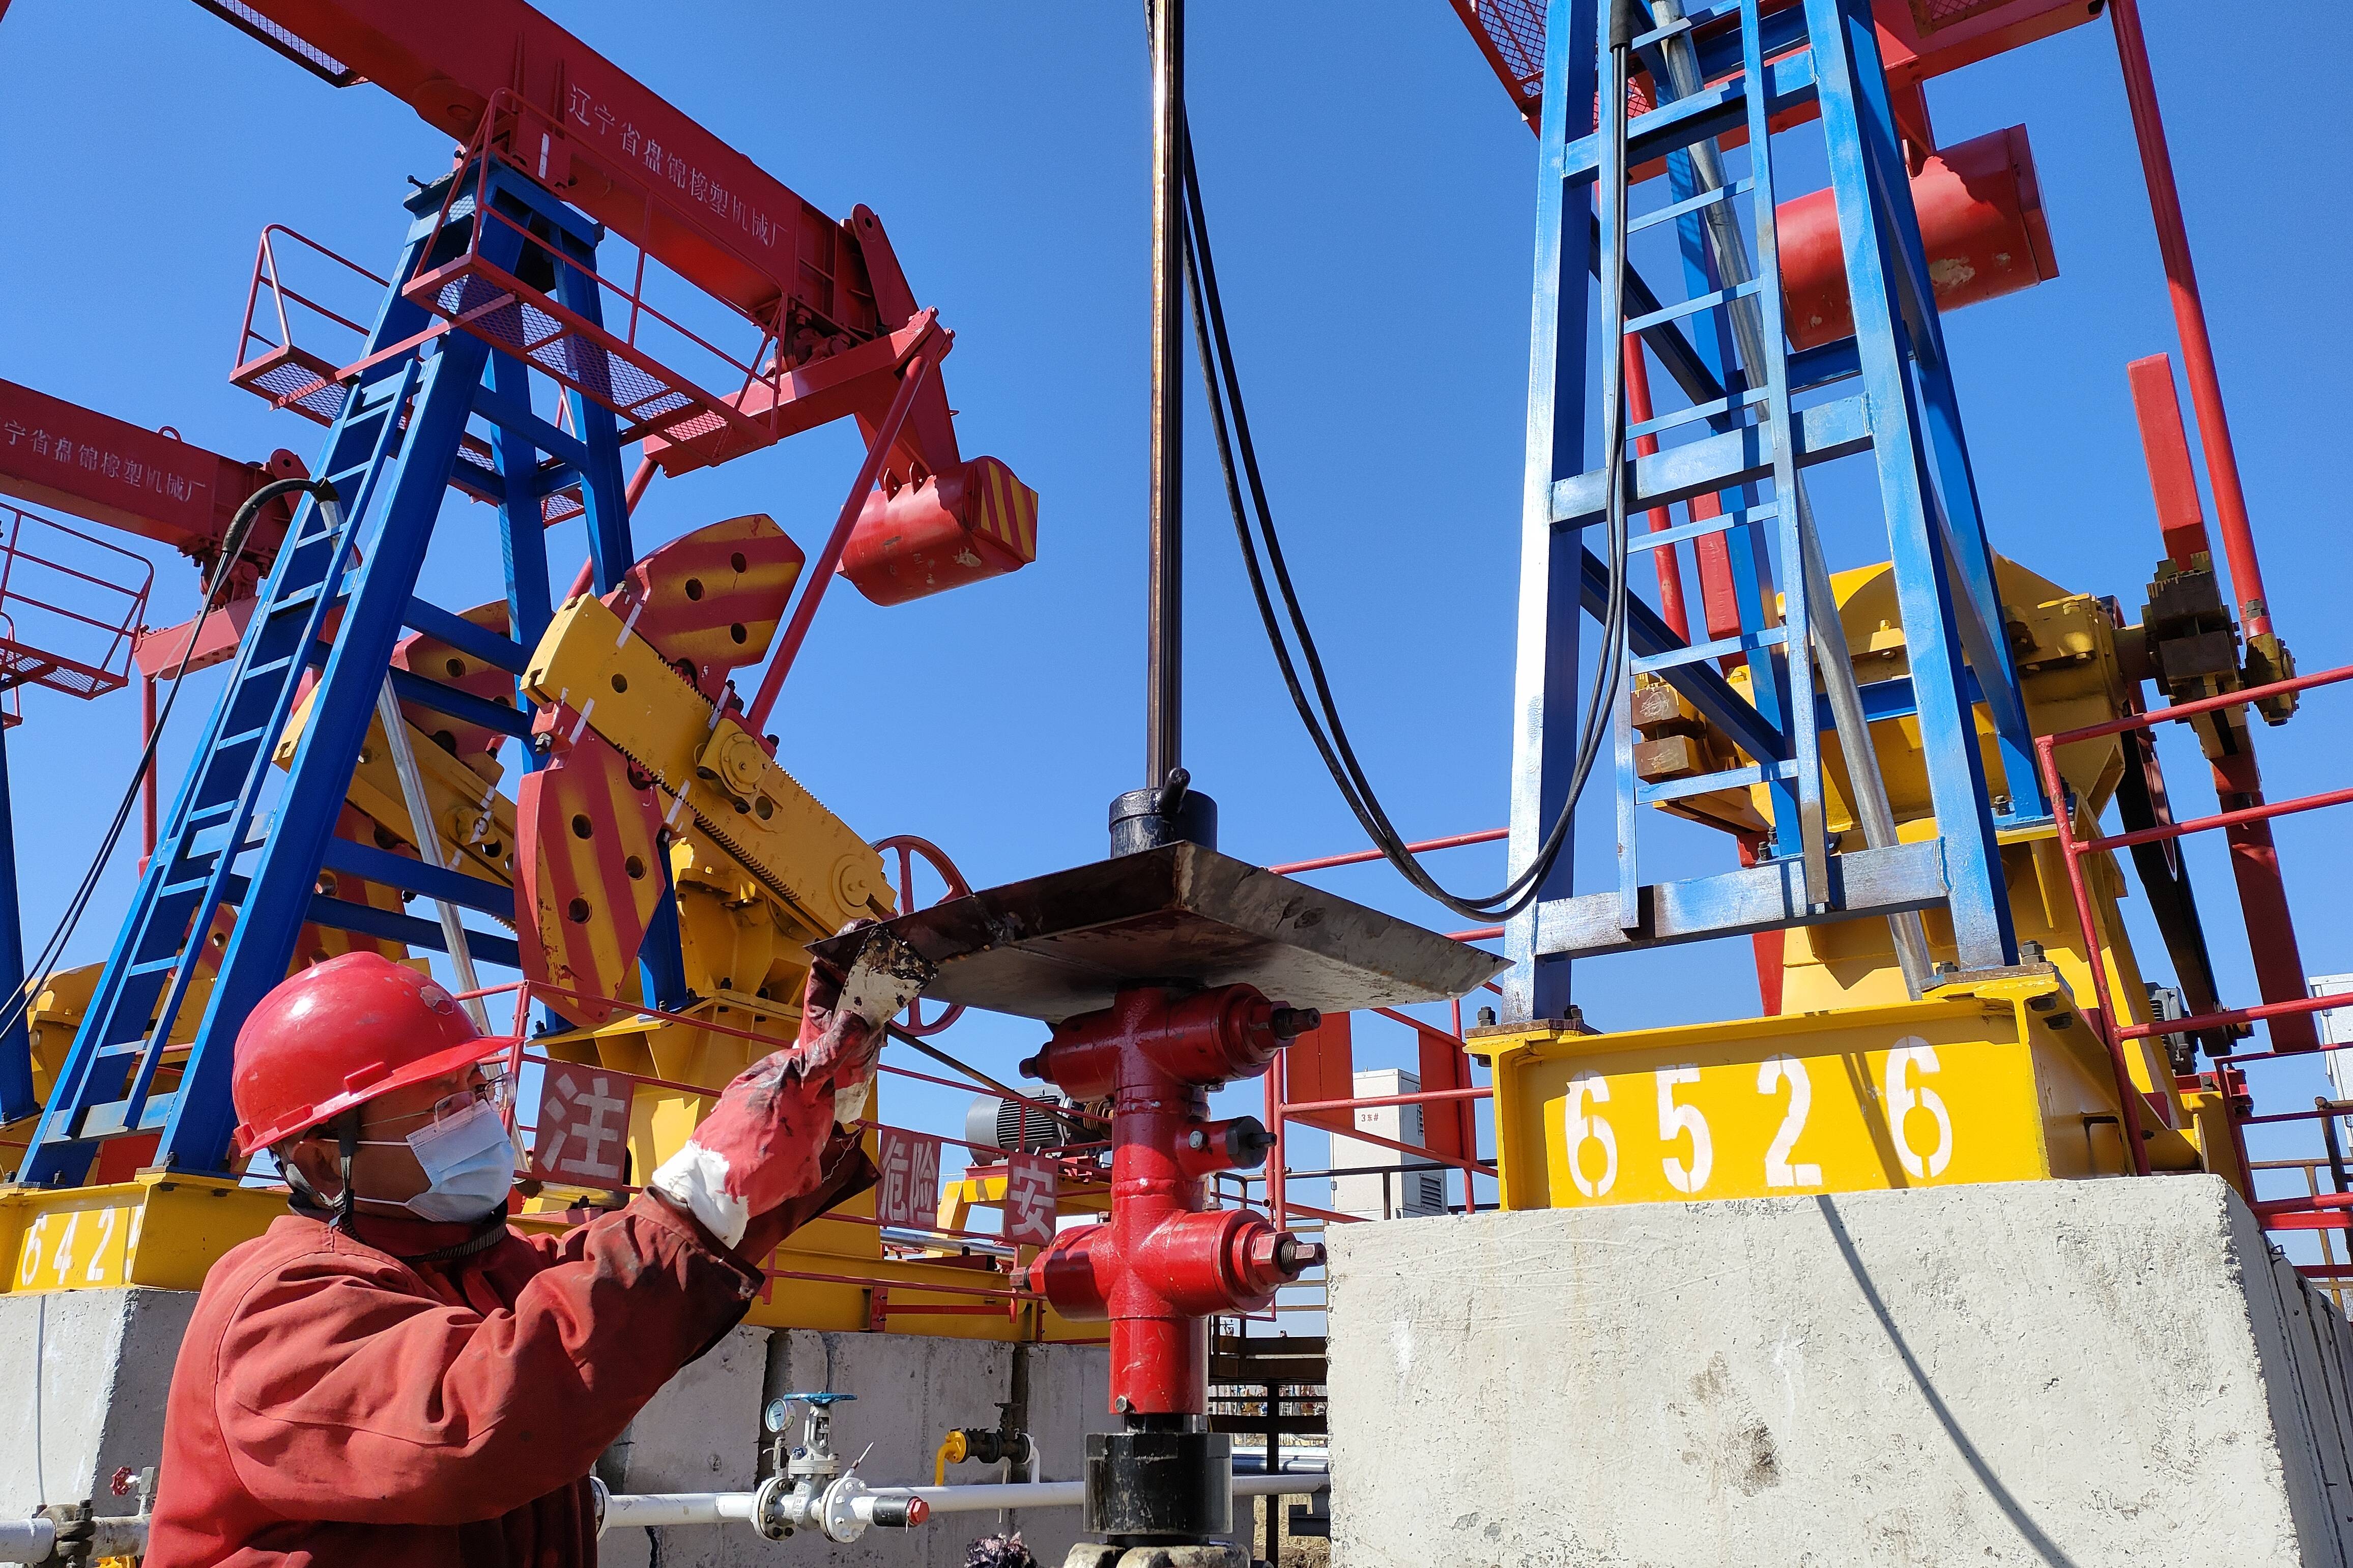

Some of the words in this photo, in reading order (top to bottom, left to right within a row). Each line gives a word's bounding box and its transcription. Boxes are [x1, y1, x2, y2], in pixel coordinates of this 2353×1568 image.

[569, 83, 788, 248] 辽宁省盘锦橡塑机械厂
[540, 1073, 625, 1179] 注
[1564, 1035, 1953, 1198] 6526
[879, 1135, 935, 1221] 危险
[1010, 1160, 1055, 1243] 安
